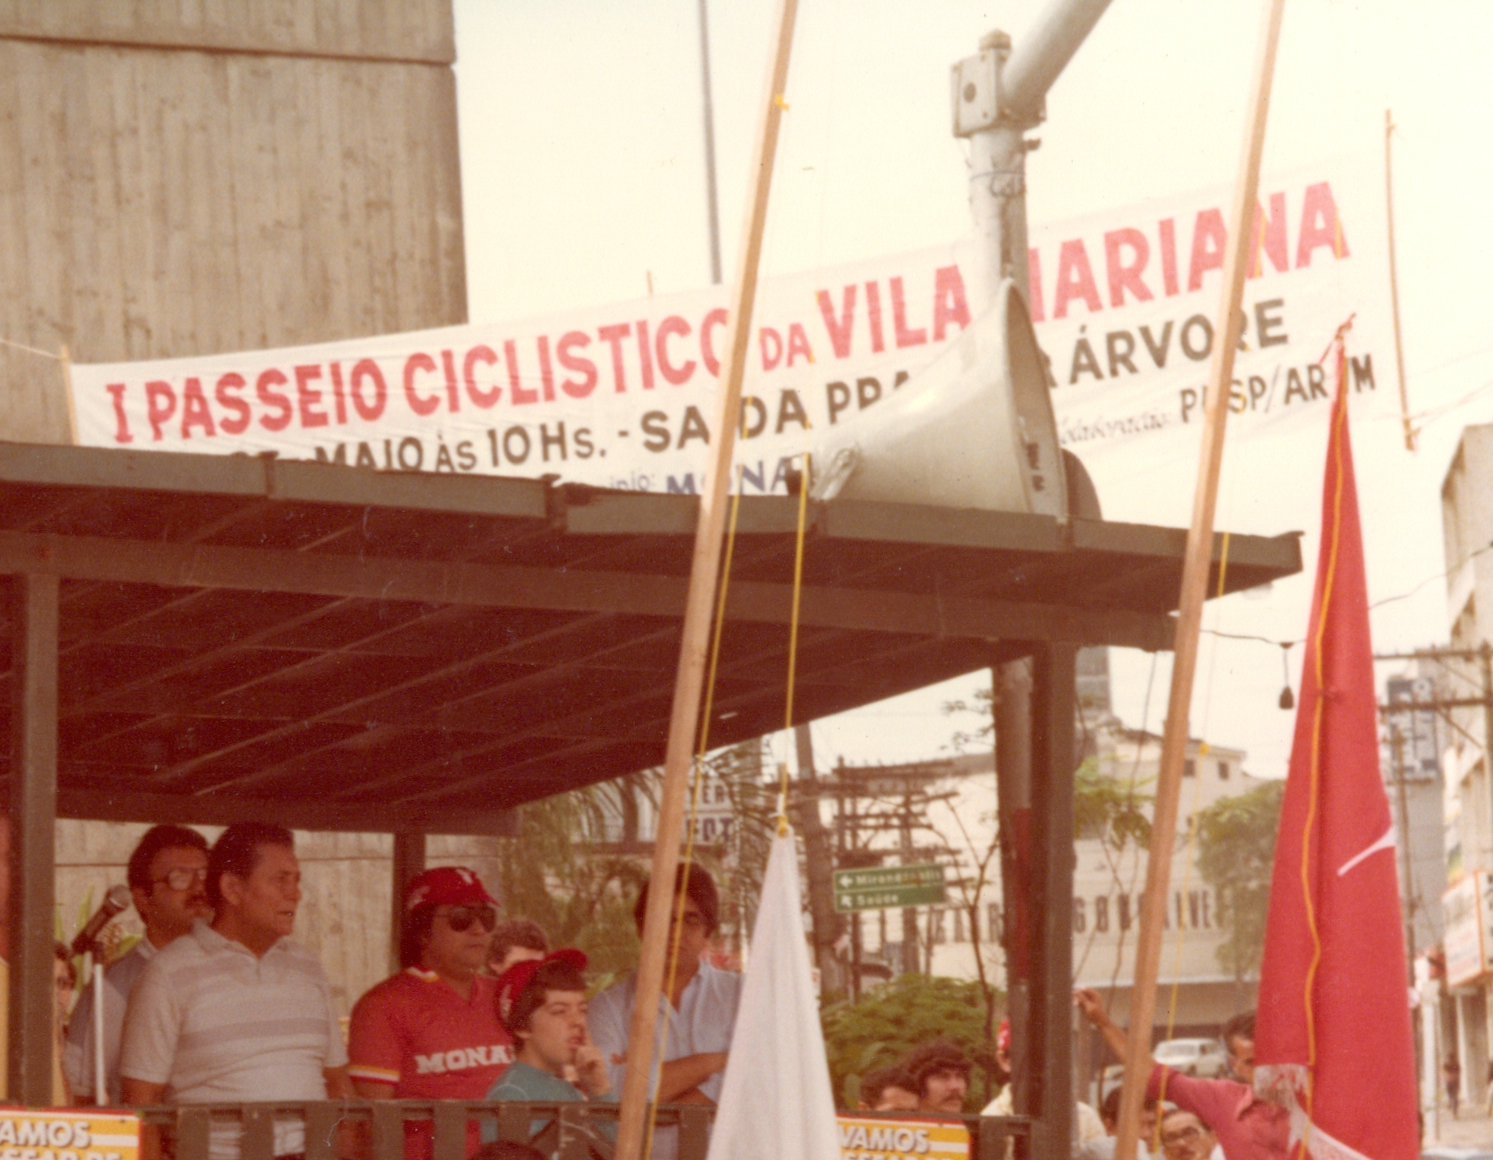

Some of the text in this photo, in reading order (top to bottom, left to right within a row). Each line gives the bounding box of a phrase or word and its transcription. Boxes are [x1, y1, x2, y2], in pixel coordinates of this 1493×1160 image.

[105, 382, 134, 443] I
[145, 358, 388, 442] PASSEIO
[758, 323, 816, 372] DA
[816, 264, 973, 360] VILA
[1179, 353, 1376, 425] PSP/ARM
[487, 424, 532, 468] 10
[639, 388, 813, 453] SADA
[838, 1125, 931, 1154] VAMOS
